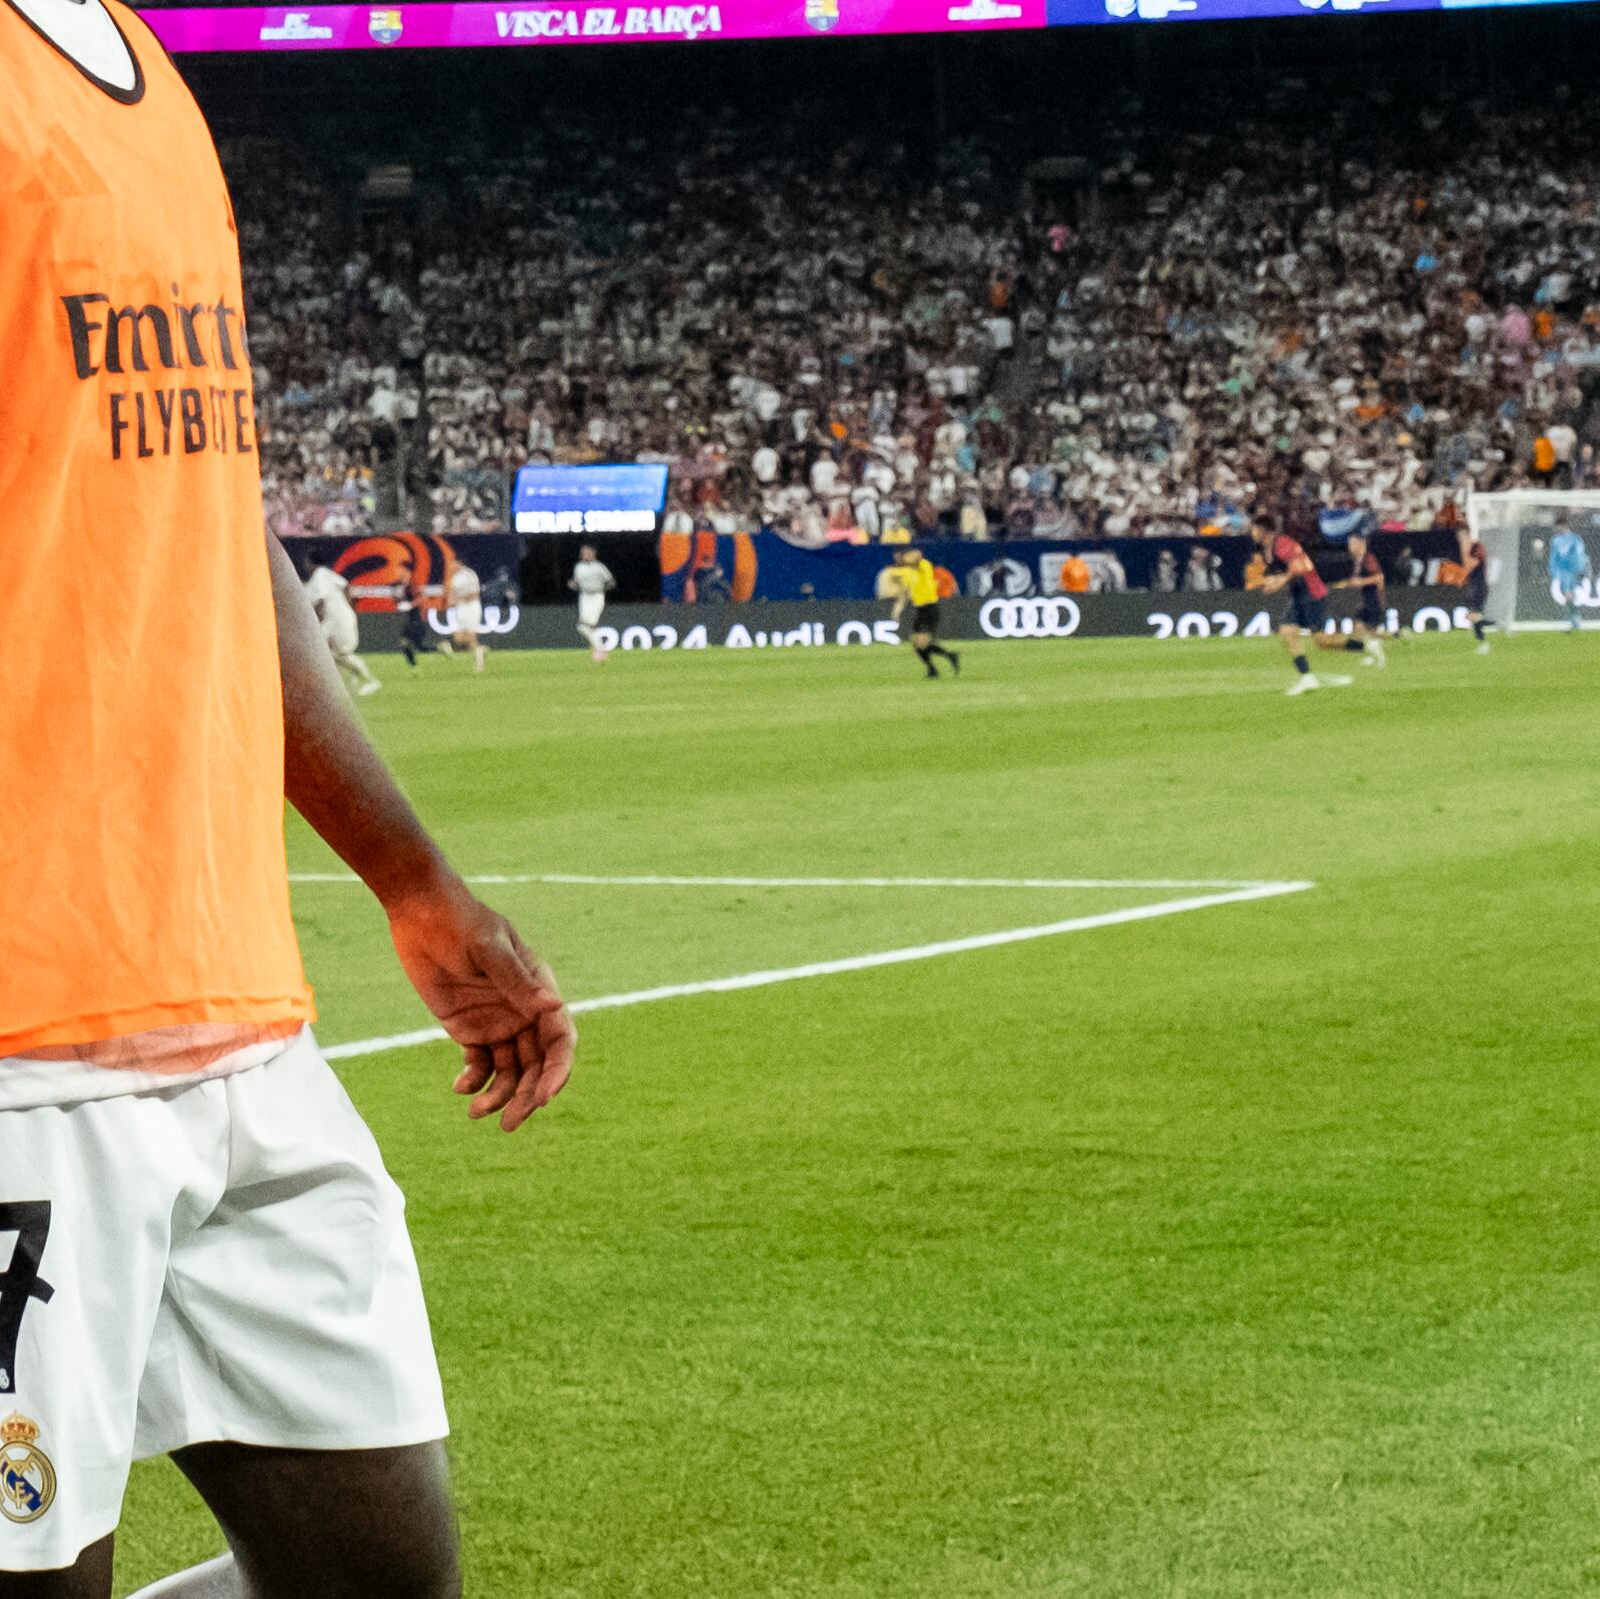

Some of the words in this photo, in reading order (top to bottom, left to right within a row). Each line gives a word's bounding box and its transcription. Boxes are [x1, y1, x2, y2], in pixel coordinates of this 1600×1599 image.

[495, 10, 578, 38] VISCA
[583, 9, 622, 35] EL
[624, 5, 721, 39] BARÇA
[725, 622, 824, 649] Audi
